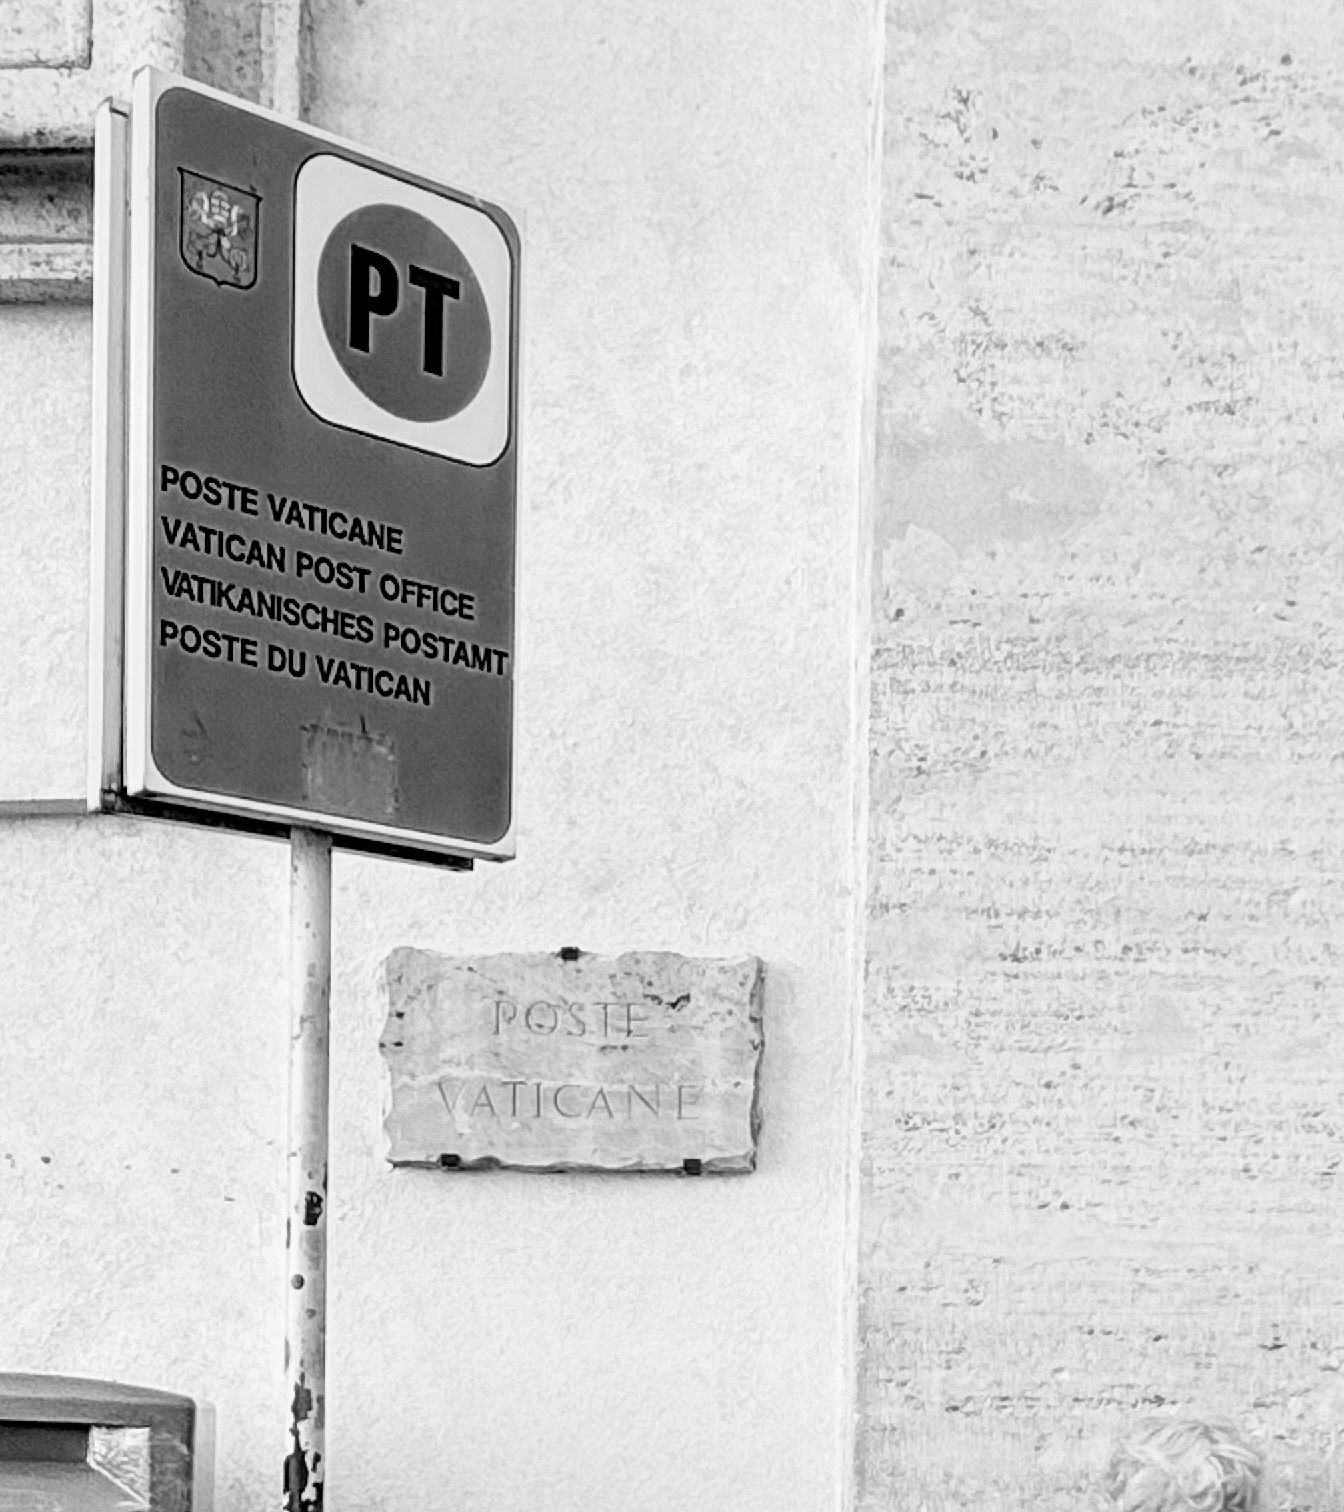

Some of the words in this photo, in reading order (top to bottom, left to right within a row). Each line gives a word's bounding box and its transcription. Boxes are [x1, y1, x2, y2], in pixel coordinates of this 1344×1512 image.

[349, 243, 460, 377] PT
[161, 465, 258, 516] POSTE
[267, 494, 404, 554] VATICANE
[161, 516, 285, 573] VATICAN
[296, 551, 371, 594] POST
[380, 573, 475, 620] OFFICE
[160, 567, 374, 643] VATIKANISCHES
[383, 622, 508, 675] POSTAMT
[160, 619, 258, 667] POSTE
[268, 644, 306, 678] DU
[316, 654, 431, 706] VATICAN
[492, 998, 651, 1038] POSTE
[438, 1080, 701, 1120] VATICANE
